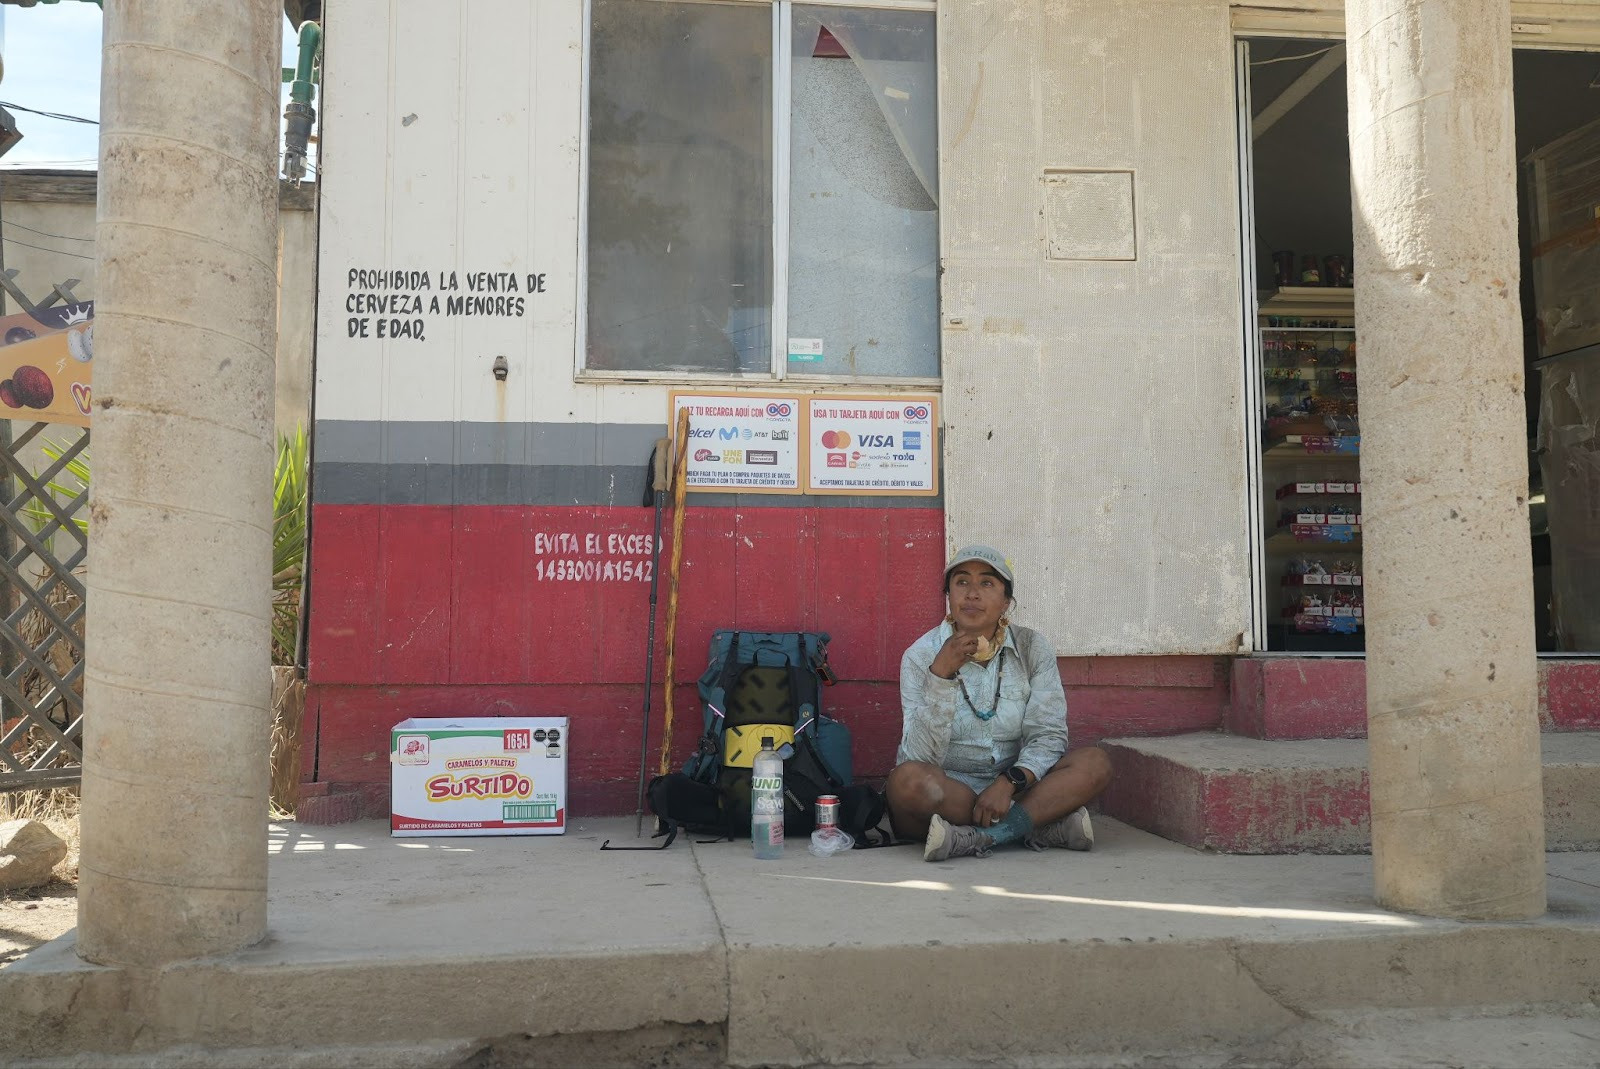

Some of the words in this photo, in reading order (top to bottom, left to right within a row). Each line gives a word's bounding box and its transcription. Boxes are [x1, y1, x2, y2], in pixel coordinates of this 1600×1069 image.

[348, 268, 431, 291] PROHIBIDA
[439, 271, 459, 291] LA
[467, 272, 519, 293] VENTA
[527, 273, 546, 294] DE
[345, 293, 423, 315] CERVEZA
[428, 295, 441, 315] A
[446, 296, 525, 317] MENORES
[348, 317, 370, 339] DE
[681, 405, 694, 416] AZ
[696, 406, 704, 416] TU
[705, 406, 734, 417] RECARGA
[735, 405, 750, 418] AQUÍ
[751, 408, 764, 418] CON
[813, 409, 827, 419] USA
[829, 409, 838, 419] TU
[840, 409, 867, 420] TARJETA
[869, 407, 885, 420] AQUÍ
[887, 410, 900, 420] CON
[688, 428, 716, 438] elcel
[858, 434, 895, 448] VISA
[723, 457, 743, 465] FON
[535, 533, 579, 555] EVITA
[586, 533, 603, 554] EL
[507, 733, 528, 749] 1654
[447, 759, 483, 769] CARAMELOS
[484, 759, 489, 767] Y
[490, 759, 516, 768] PALETAS
[429, 773, 530, 798] SURTIDO
[753, 777, 781, 790] UND
